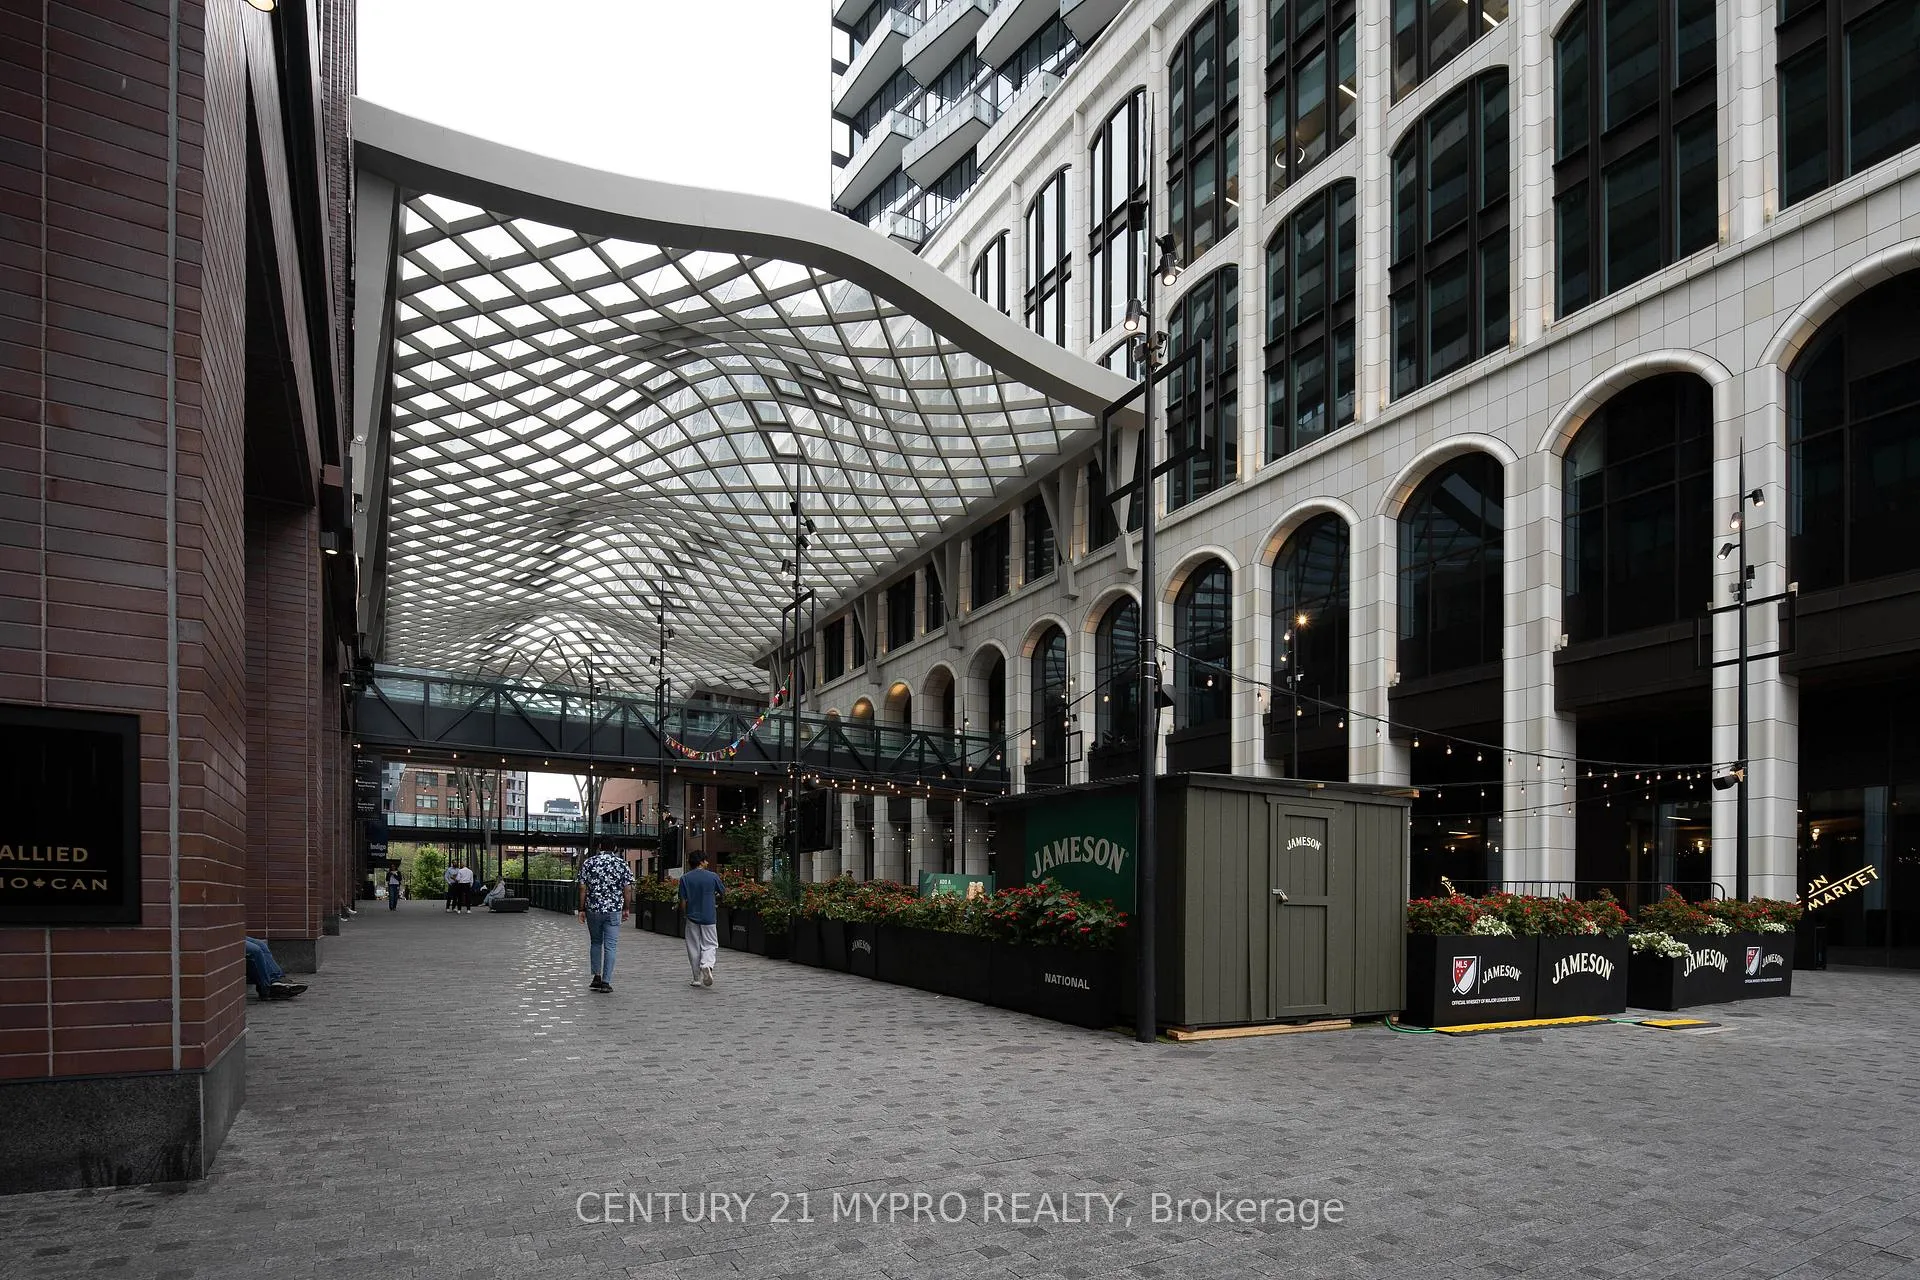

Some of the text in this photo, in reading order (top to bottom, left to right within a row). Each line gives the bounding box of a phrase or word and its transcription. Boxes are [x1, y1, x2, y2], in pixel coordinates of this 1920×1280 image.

[1286, 836, 1321, 851] JAMESON
[0, 845, 88, 863] ALLIED
[1032, 835, 1126, 879] JAMESON
[1808, 867, 1879, 911] MARKET
[1455, 960, 1468, 969] MLS
[1552, 952, 1613, 985] JAMESON
[1683, 948, 1728, 978] JAMESON
[1044, 972, 1091, 990] NATIONAL
[1482, 964, 1521, 984] JAMESON
